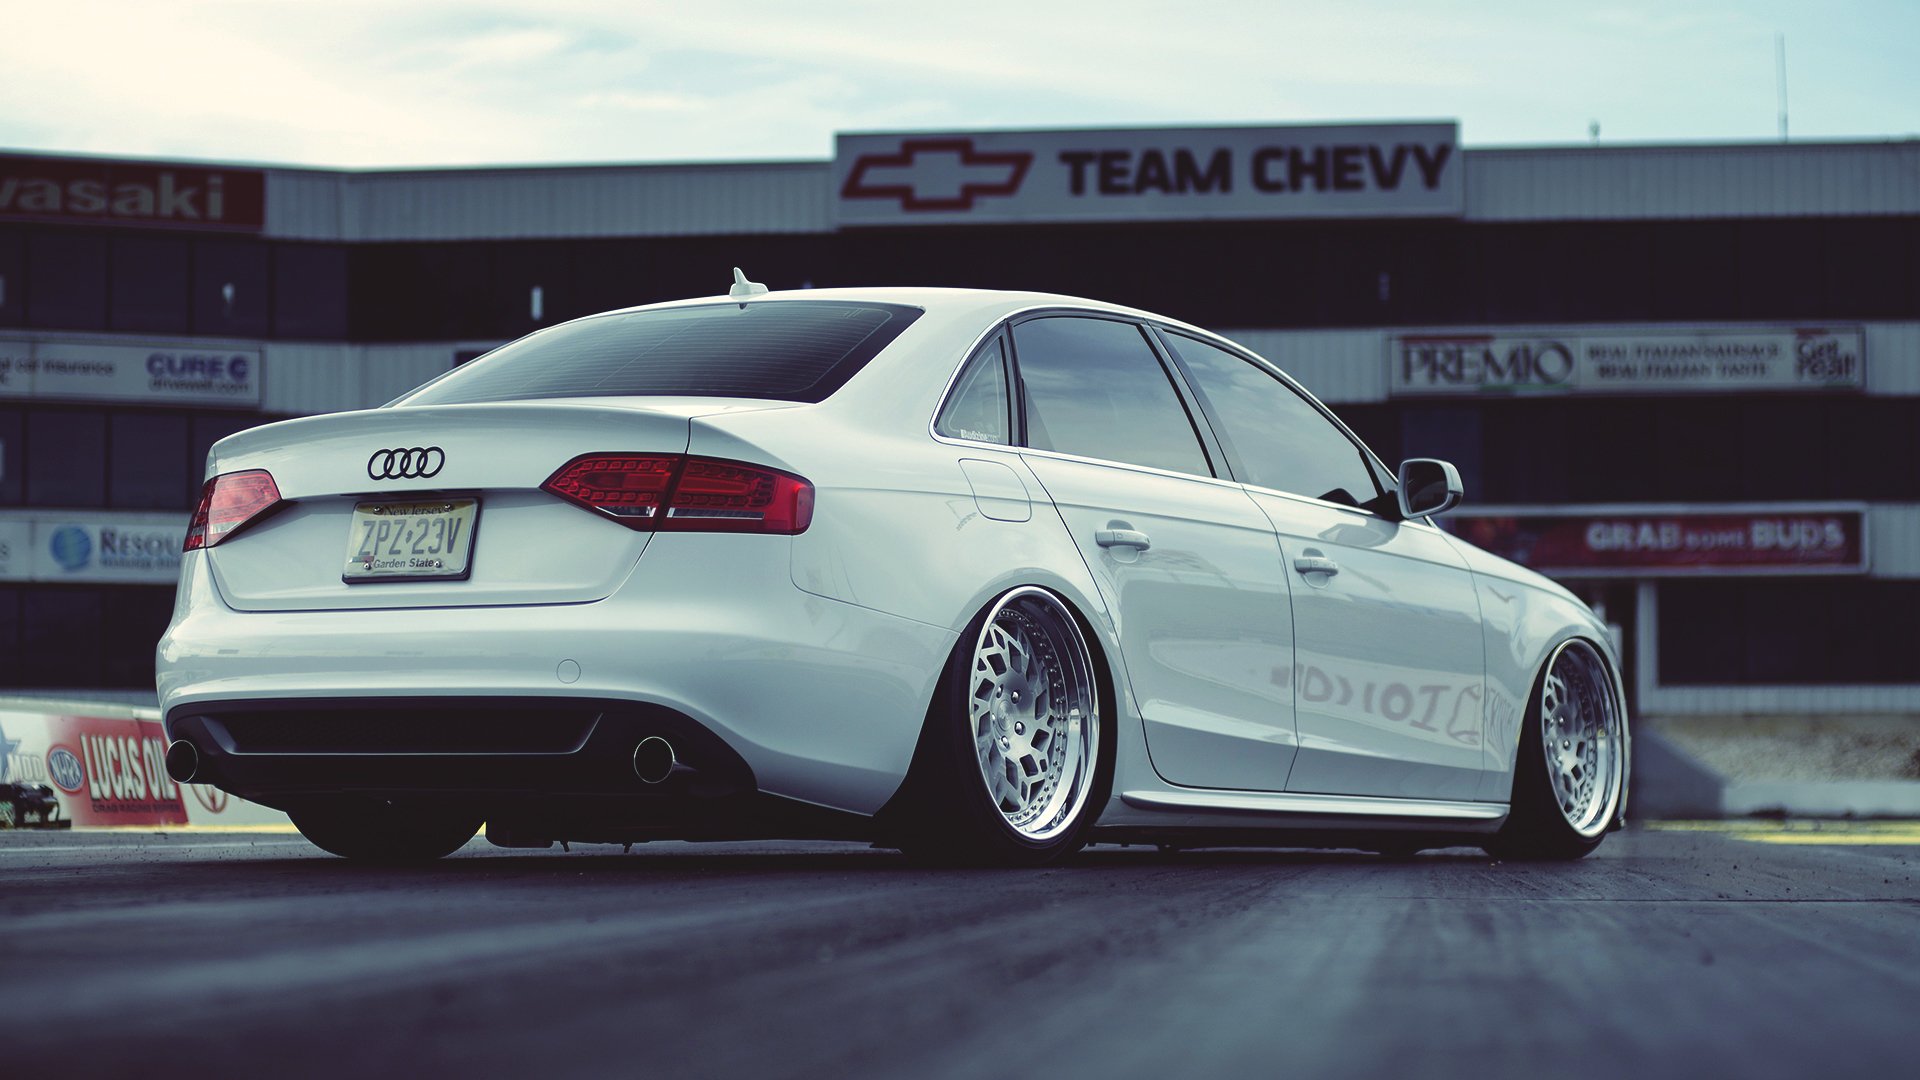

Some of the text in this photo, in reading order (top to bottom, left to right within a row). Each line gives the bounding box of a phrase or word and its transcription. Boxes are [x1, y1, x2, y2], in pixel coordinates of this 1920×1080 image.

[1058, 143, 1453, 196] TEAM CHEVY
[0, 173, 223, 220] asaki
[146, 352, 223, 377] CURE
[1402, 341, 1574, 385] PREMIO
[384, 506, 408, 516] New
[100, 528, 180, 556] RESOU
[1586, 521, 1681, 551] GRAB
[1752, 519, 1846, 550] BUDS
[374, 558, 434, 568] Garden State
[80, 732, 177, 801] LUCAS OIL
